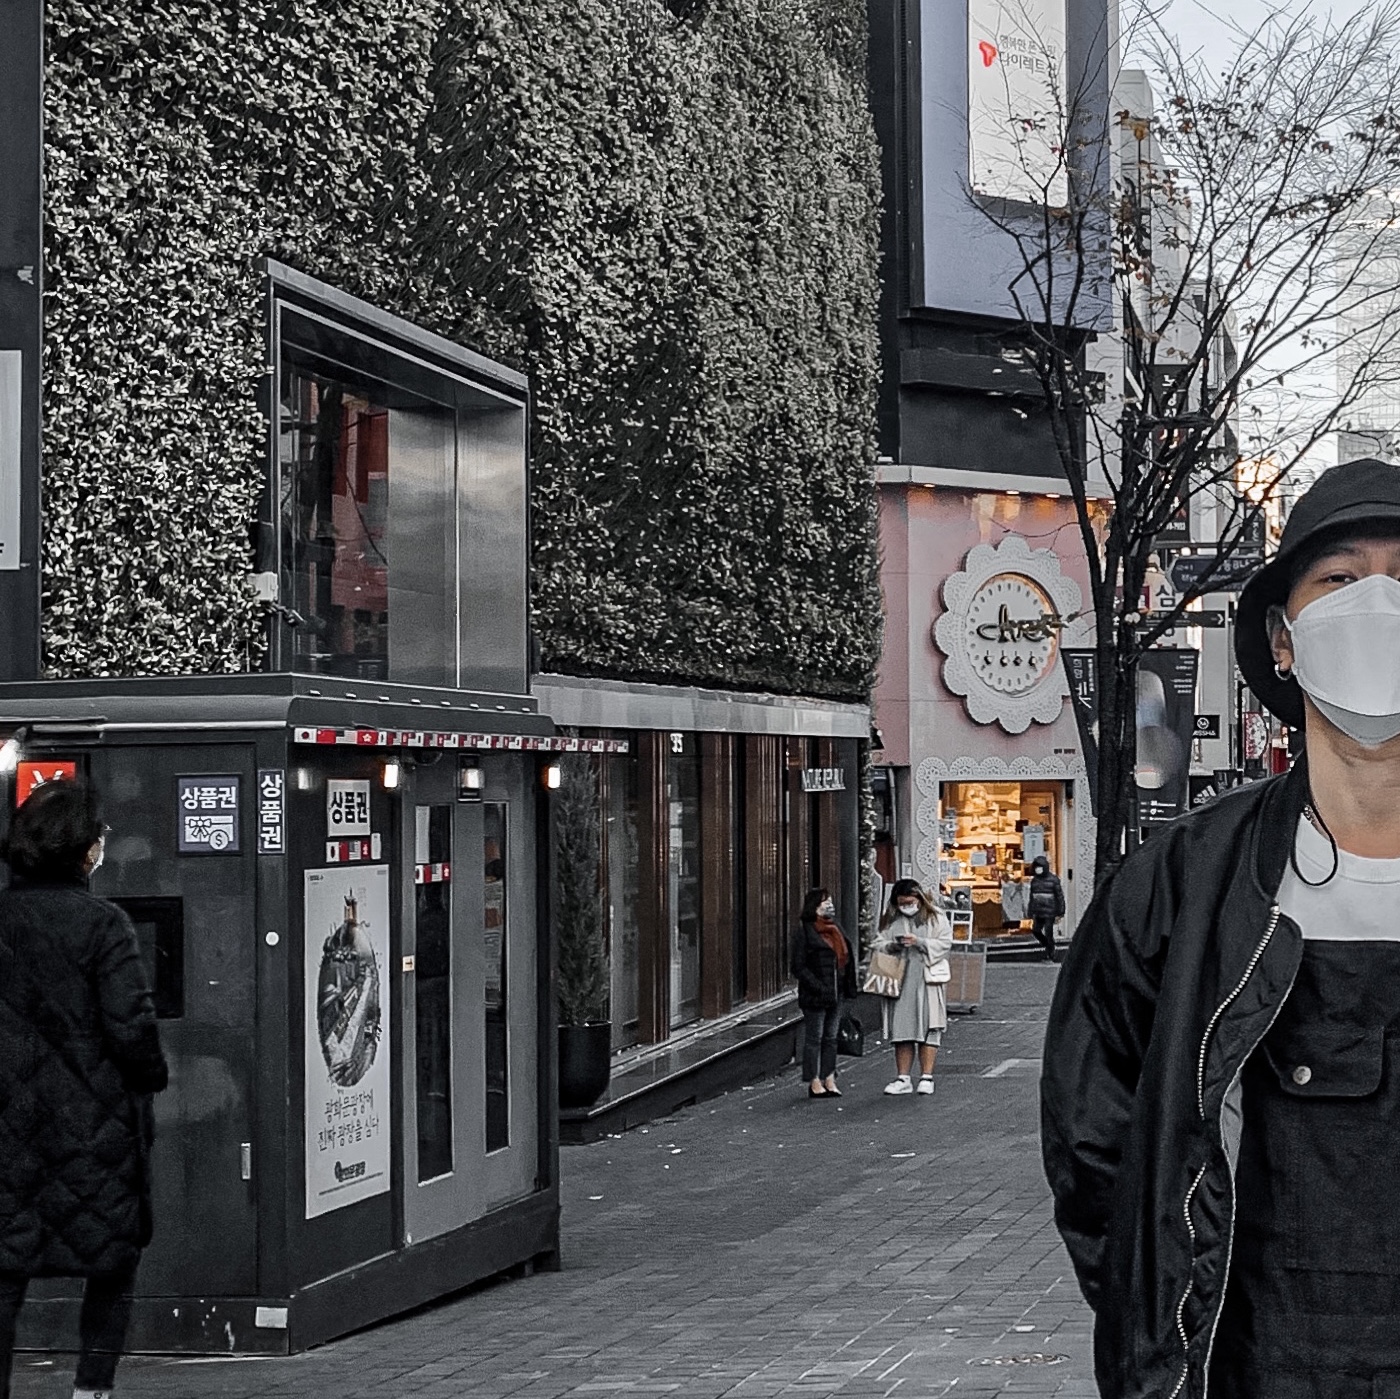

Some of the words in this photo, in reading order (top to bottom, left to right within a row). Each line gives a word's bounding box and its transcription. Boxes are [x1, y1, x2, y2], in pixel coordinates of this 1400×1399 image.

[180, 786, 237, 810] 상품권
[260, 774, 283, 849] 상품권
[331, 791, 368, 824] 상품권
